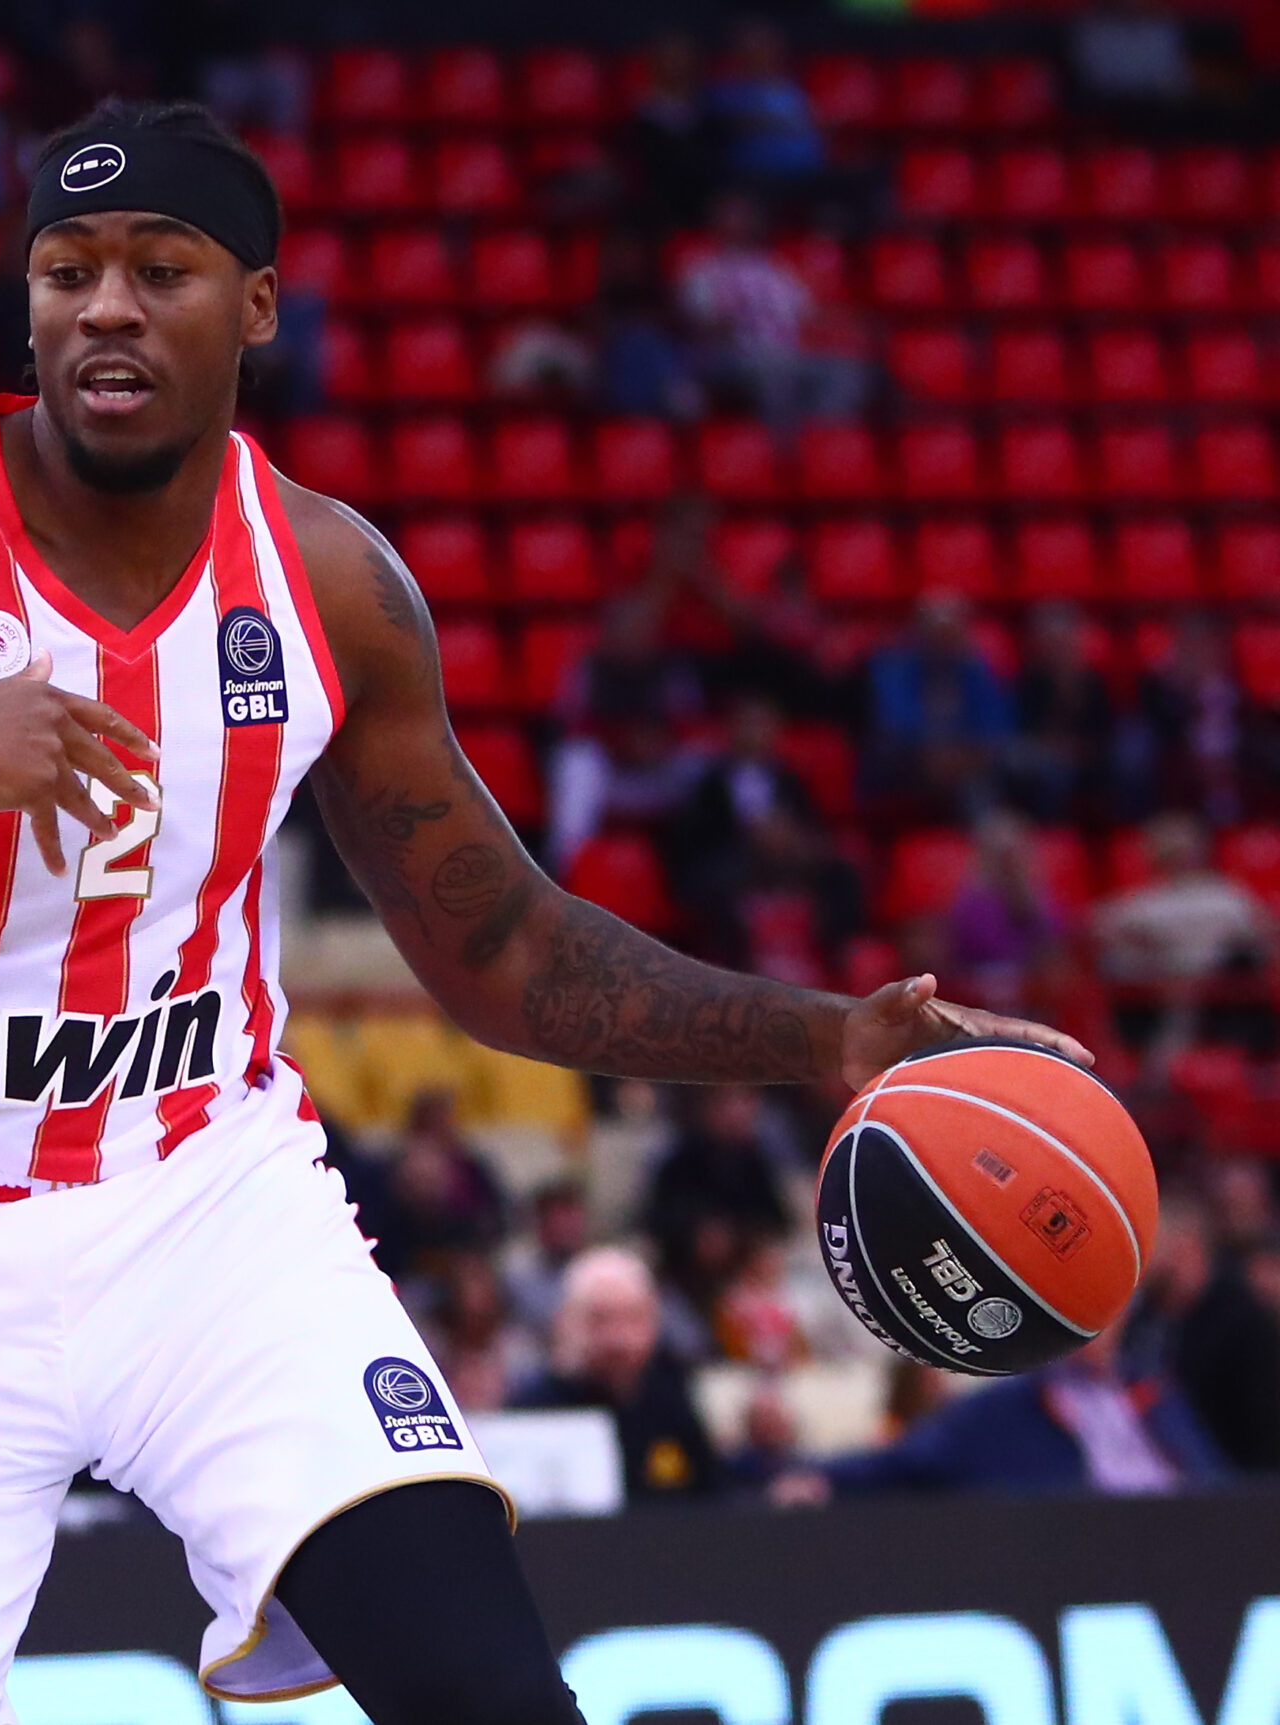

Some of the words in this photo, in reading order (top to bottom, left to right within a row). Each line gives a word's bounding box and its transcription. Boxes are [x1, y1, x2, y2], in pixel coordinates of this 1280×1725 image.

[223, 679, 284, 695] Stoiximan
[227, 693, 284, 722] GBL
[74, 769, 163, 901] 2
[922, 1239, 977, 1303] GBL
[890, 1266, 983, 1355] Stoiximan
[384, 1413, 450, 1429] Stoiximan
[393, 1424, 458, 1448] GBL
